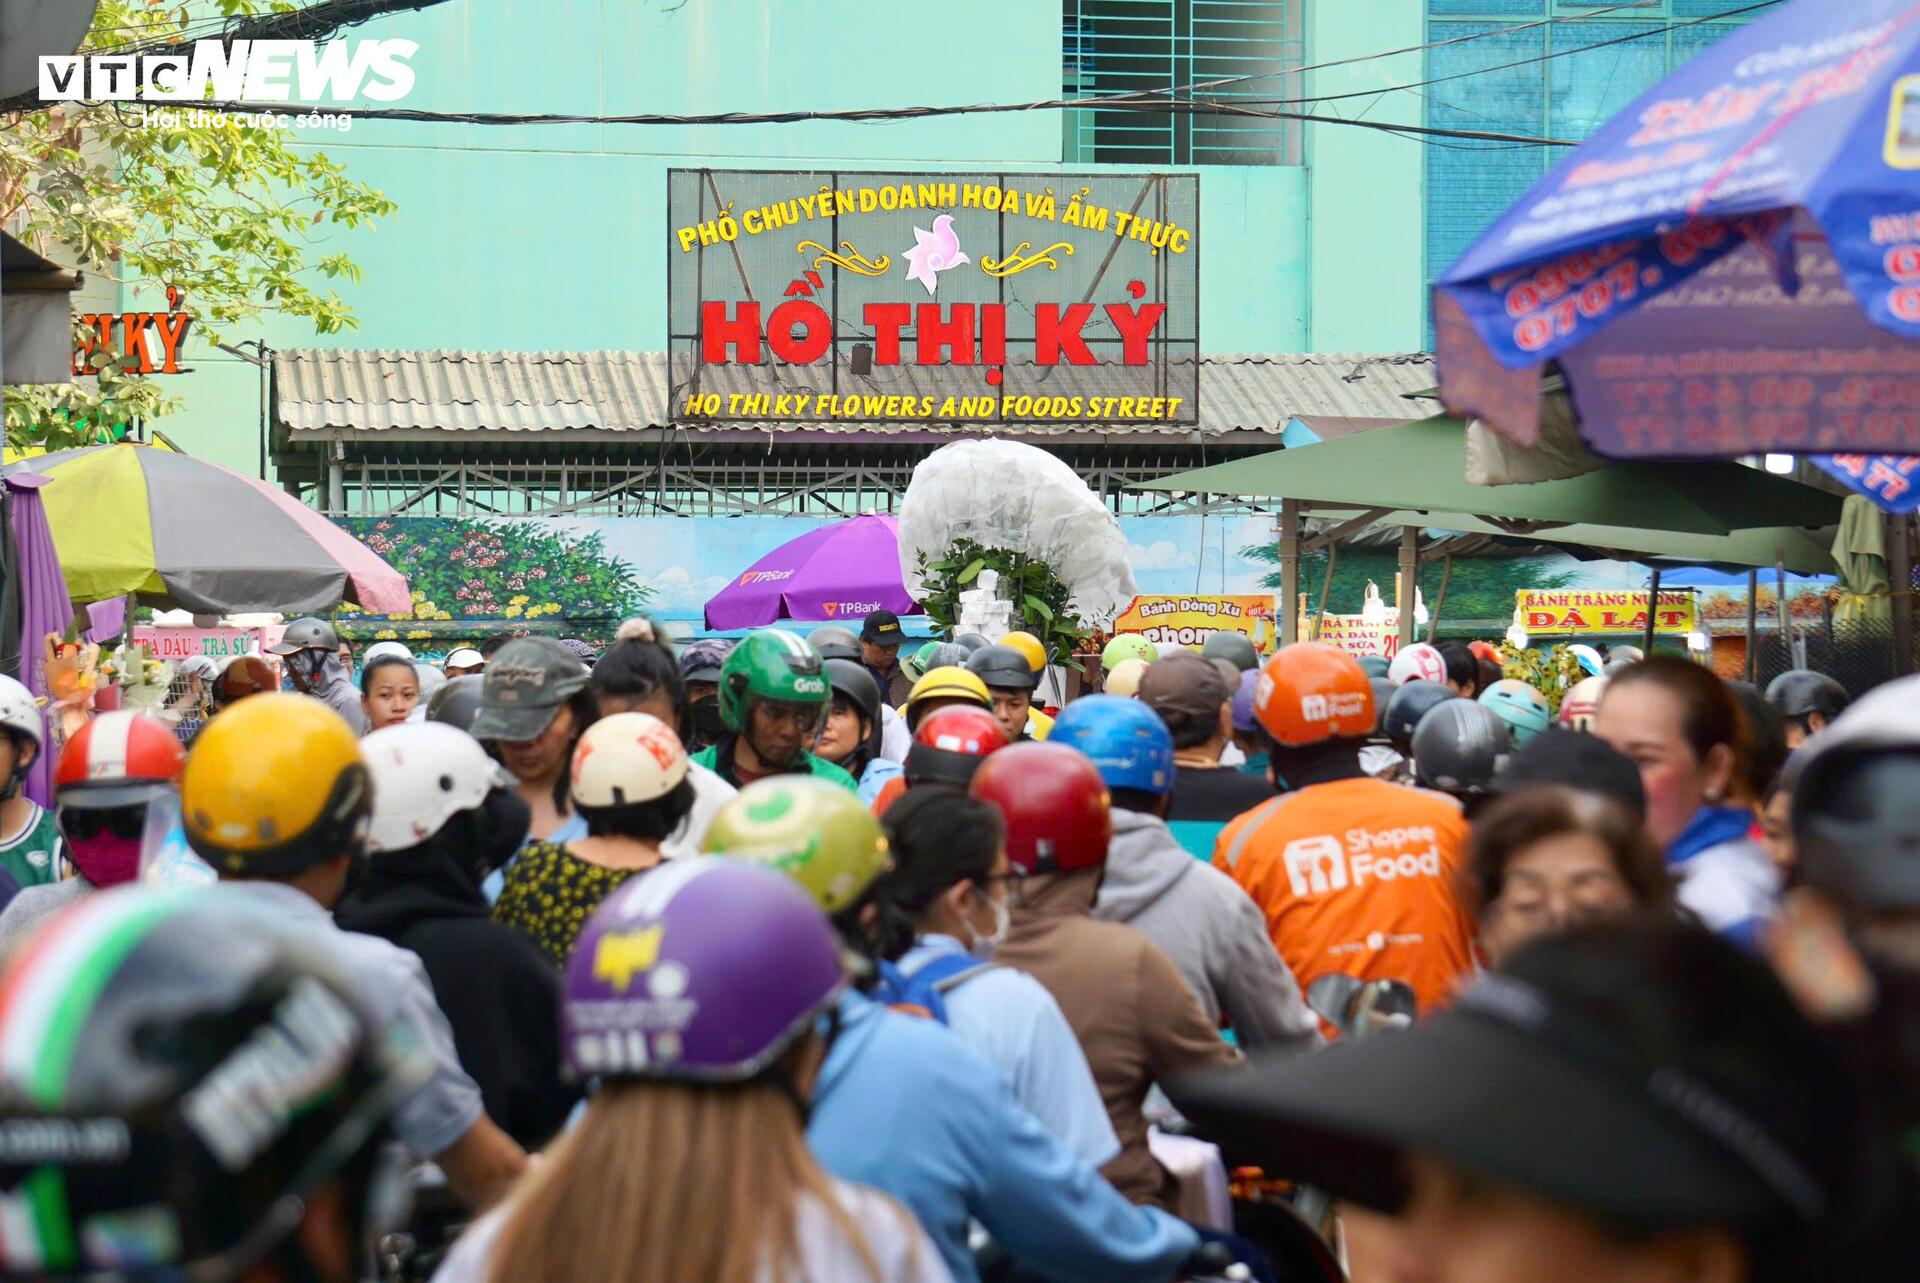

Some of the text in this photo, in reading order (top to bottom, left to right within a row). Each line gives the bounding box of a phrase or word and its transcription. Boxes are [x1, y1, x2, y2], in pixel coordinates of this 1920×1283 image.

[676, 183, 1191, 257] PHỐ CHUYÊN DOANH HOA VÀ ẨM THỰC
[702, 271, 1168, 386] HỒ THỊ KỶ
[684, 393, 1183, 419] HO THI KY FLOWERS AND FOODS STREET
[838, 601, 881, 615] TPBank
[1140, 597, 1241, 618] Bánh Đồng Xu
[1527, 608, 1689, 631] ĐÀ LẠT
[202, 632, 229, 656] TRÀ
[232, 632, 259, 656] SỮ
[794, 677, 825, 693] Grab
[1345, 824, 1436, 852] Shopee
[1351, 843, 1441, 888] Food
